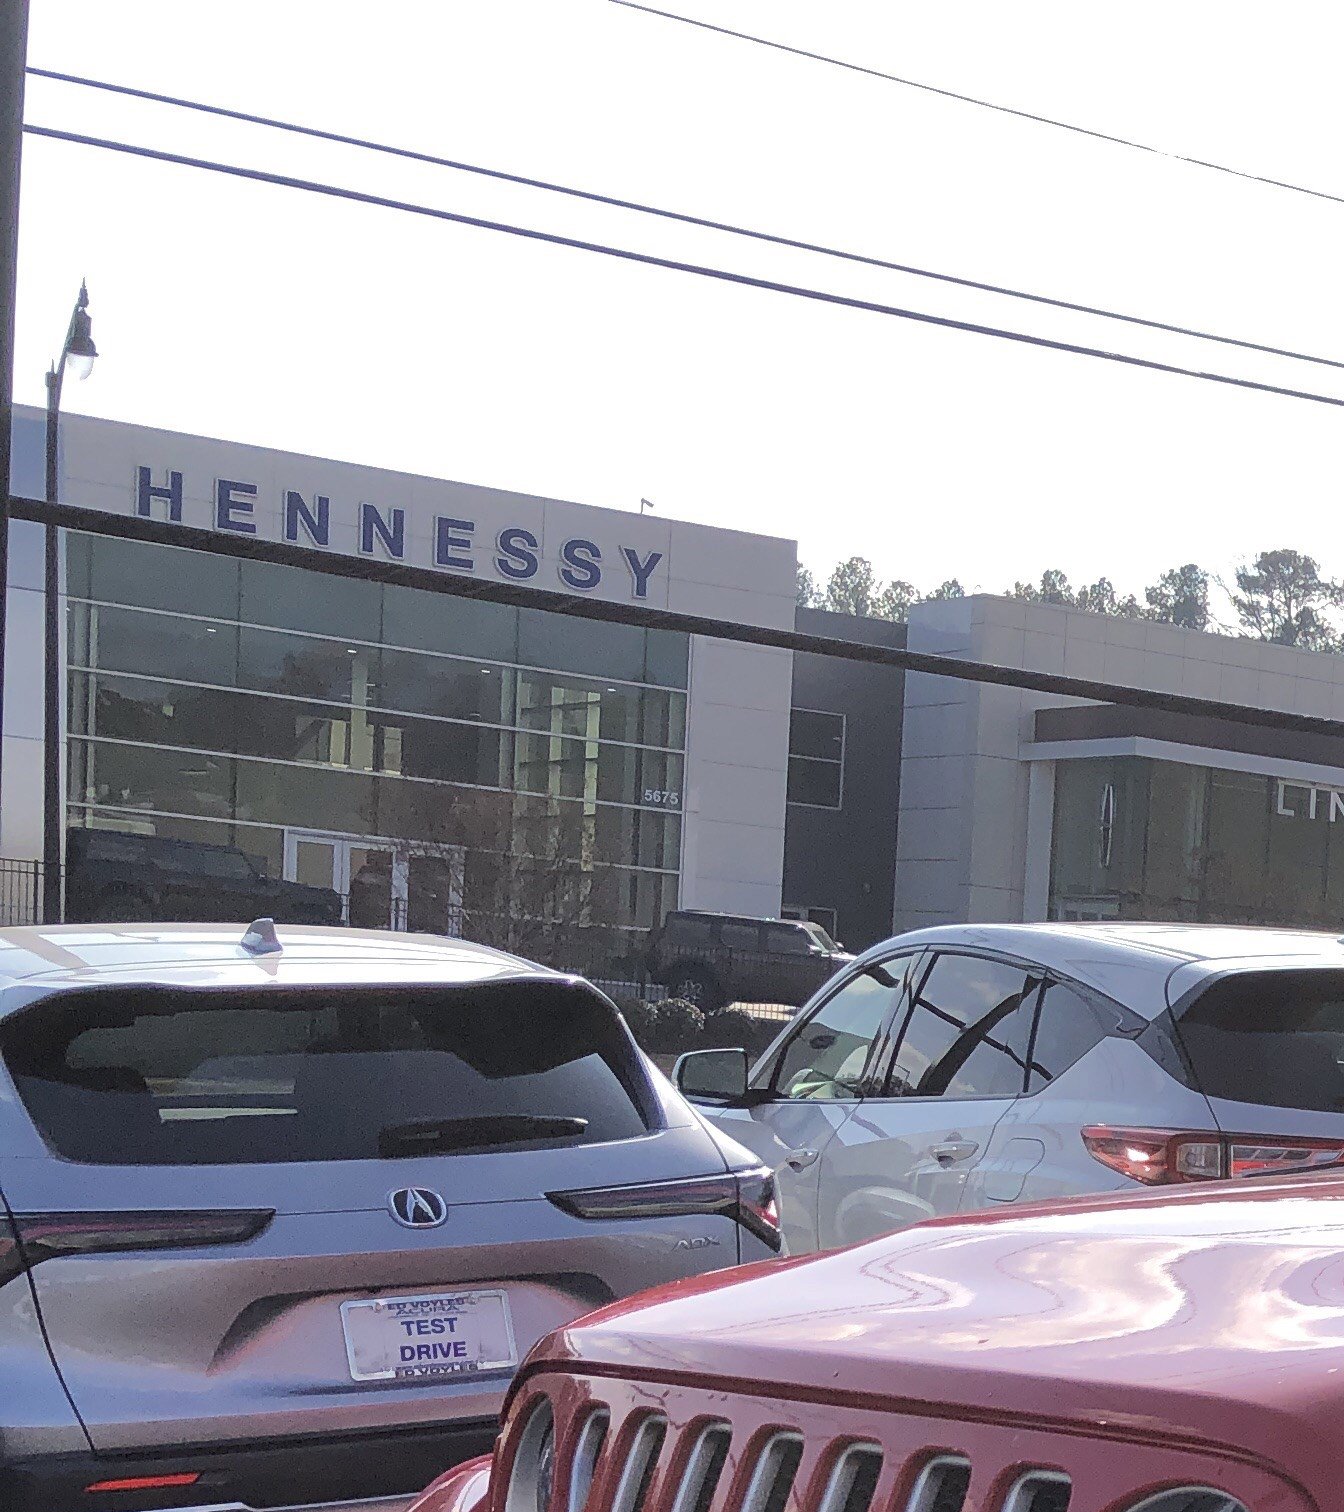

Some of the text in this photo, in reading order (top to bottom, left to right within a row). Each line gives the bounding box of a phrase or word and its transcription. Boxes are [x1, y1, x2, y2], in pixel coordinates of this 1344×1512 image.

[136, 465, 664, 598] HENNESSY
[644, 789, 679, 805] 5675
[400, 1317, 458, 1336] TEST
[400, 1341, 467, 1361] DRIVE
